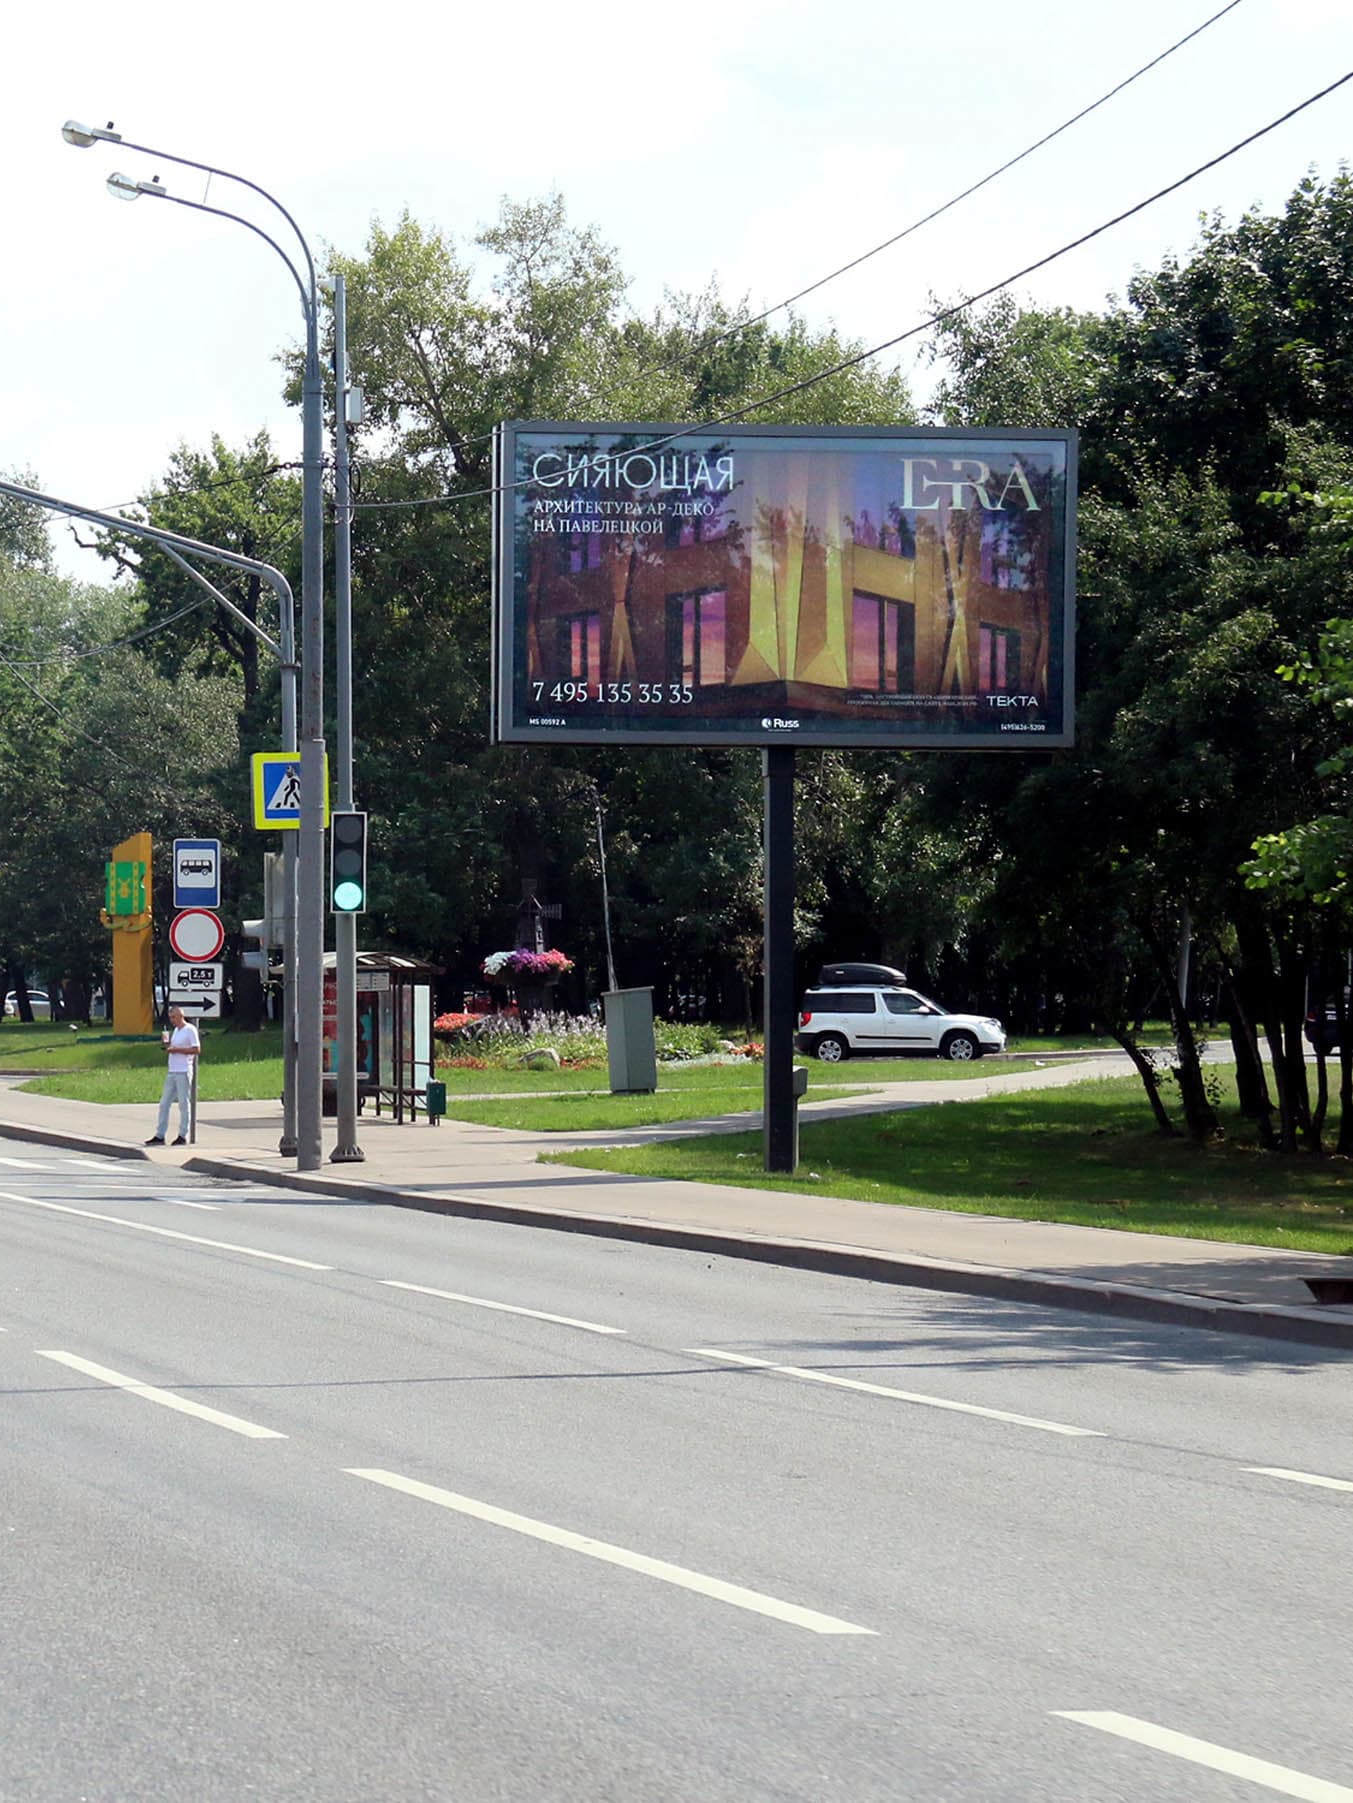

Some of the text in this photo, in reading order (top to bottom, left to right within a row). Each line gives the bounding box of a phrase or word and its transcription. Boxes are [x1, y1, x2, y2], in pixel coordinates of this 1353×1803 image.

[533, 454, 734, 495] СИЯЮЩАЯ
[900, 458, 1042, 511] ERA
[534, 500, 714, 517] АРХИТЕКТУРА АР-ДЕКО
[534, 518, 663, 534] НА ПАВЕЛЕЦКОЙ
[533, 682, 693, 704] 7 495 135 35 35
[986, 695, 1039, 707] ТЕКТА
[773, 718, 800, 728] Russ
